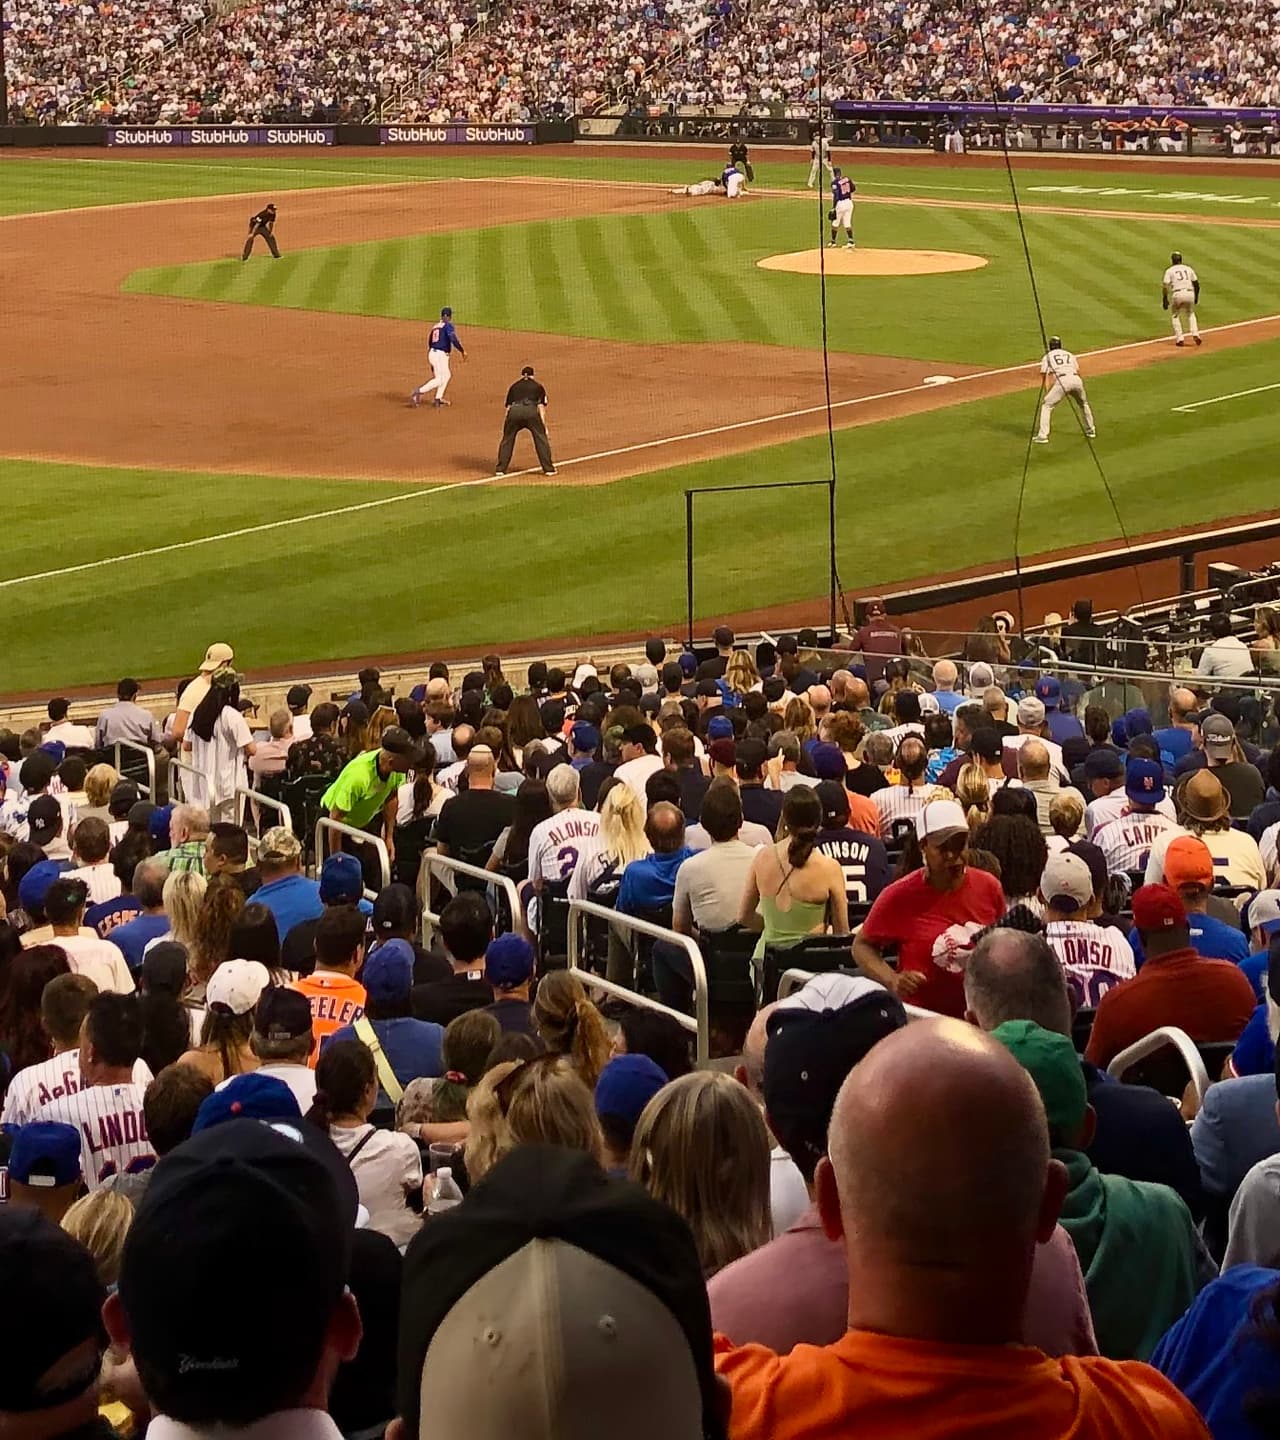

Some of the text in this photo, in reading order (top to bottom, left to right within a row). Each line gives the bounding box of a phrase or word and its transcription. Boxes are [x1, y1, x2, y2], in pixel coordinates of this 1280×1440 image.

[115, 129, 173, 144] StubHub
[191, 129, 248, 144] StubHub
[267, 129, 325, 144] StubHub
[388, 128, 447, 142] StubHub
[465, 127, 524, 142] StubHub
[1174, 269, 1190, 281] 31
[1053, 353, 1072, 366] 67
[819, 841, 870, 862] UNSON
